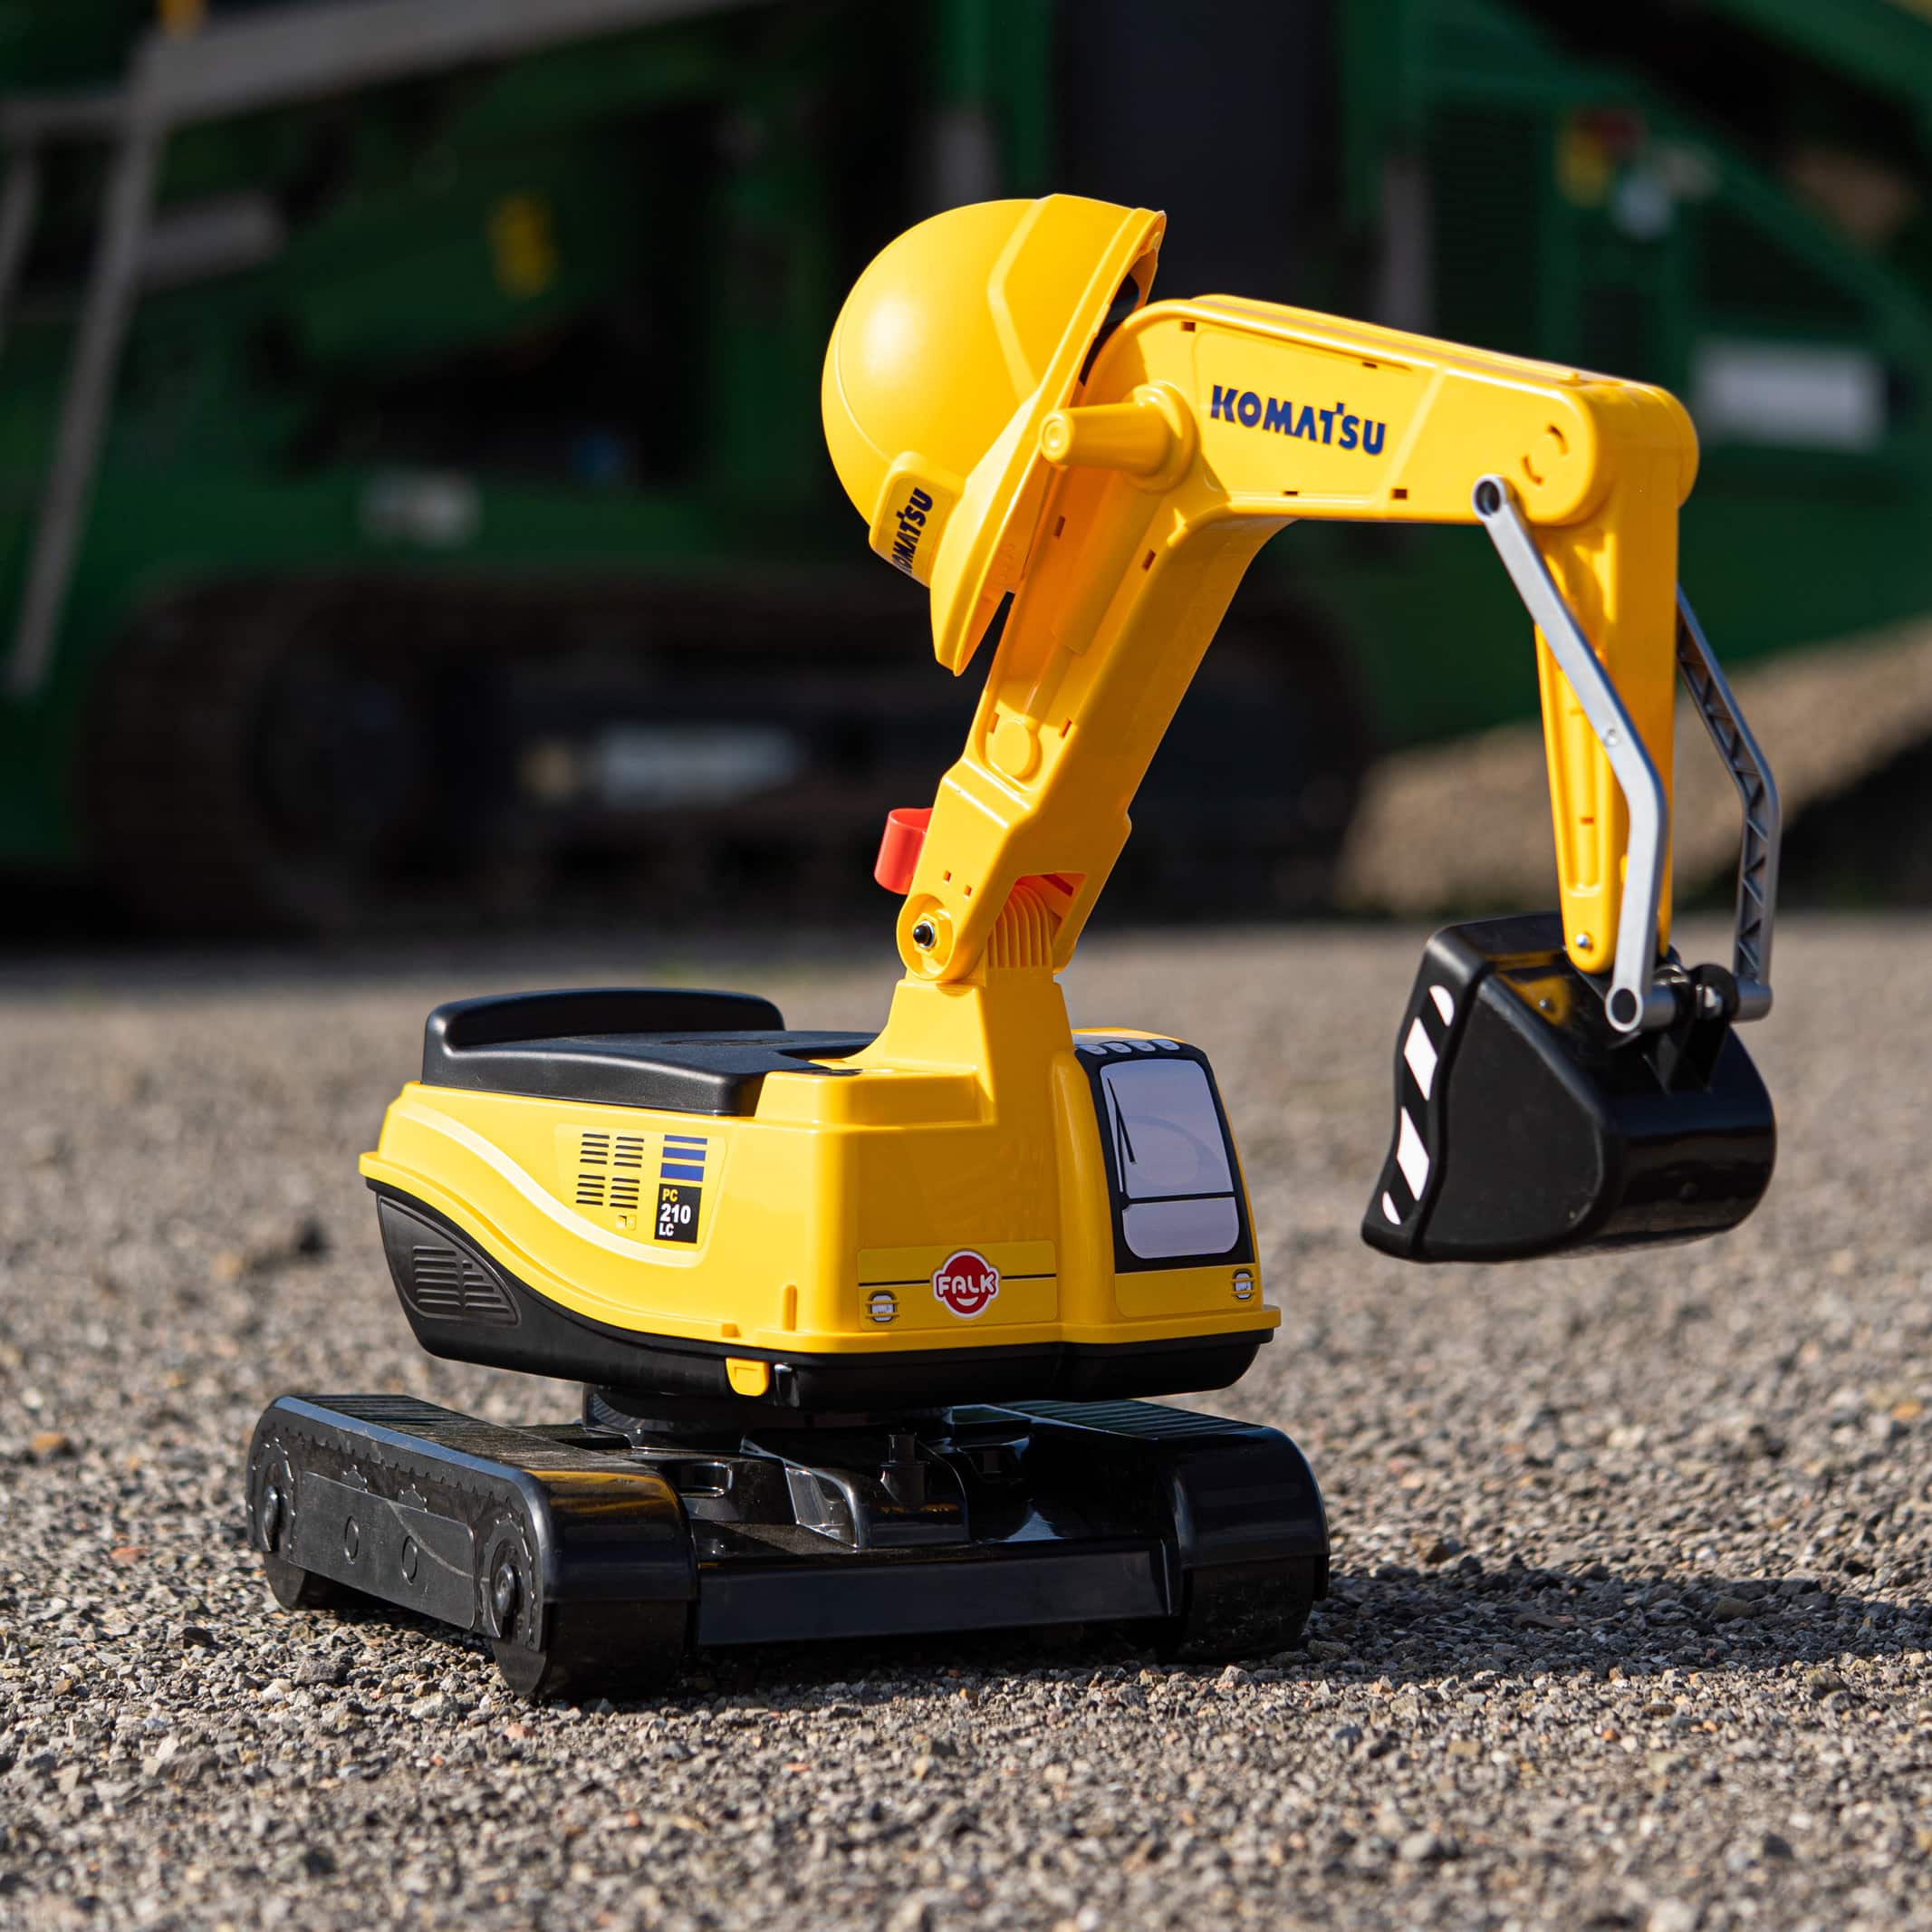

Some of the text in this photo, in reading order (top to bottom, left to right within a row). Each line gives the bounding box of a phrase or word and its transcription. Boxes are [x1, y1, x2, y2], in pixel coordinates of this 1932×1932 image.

[1210, 384, 1386, 456] KOMATSU
[891, 486, 934, 573] OMATSU
[662, 1187, 678, 1203] PC
[659, 1203, 691, 1225] 210
[658, 1223, 675, 1237] LC
[937, 1273, 995, 1295] FALK
